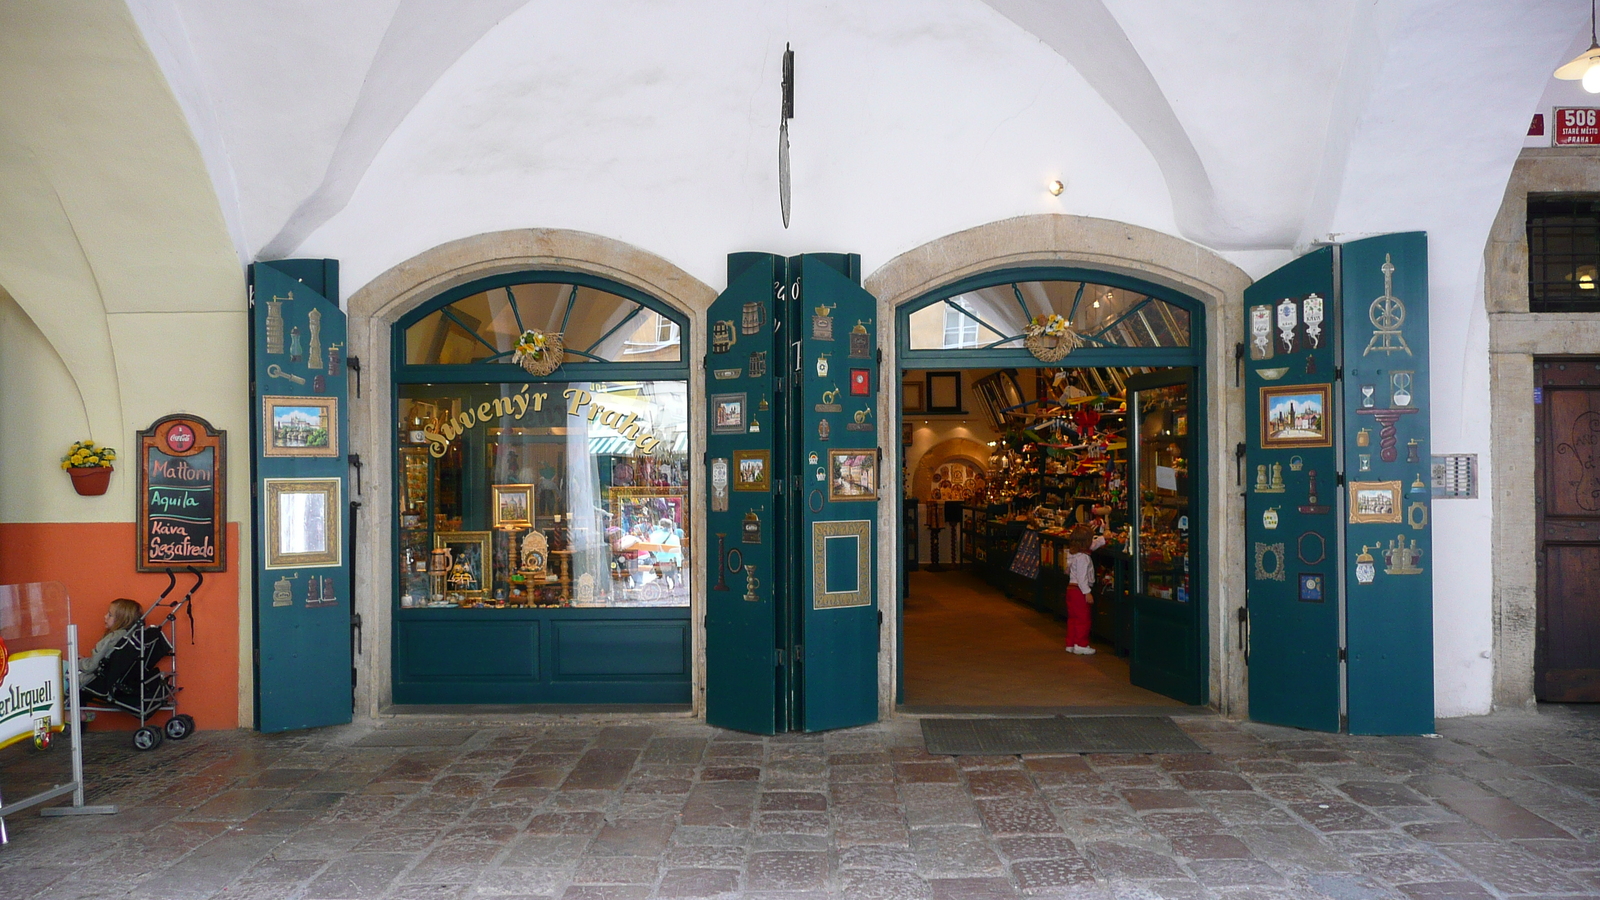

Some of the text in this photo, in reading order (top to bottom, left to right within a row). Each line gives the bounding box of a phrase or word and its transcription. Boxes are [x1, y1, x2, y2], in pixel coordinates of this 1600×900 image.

[1565, 110, 1596, 126] 506
[1562, 126, 1579, 135] STARÉ
[422, 383, 661, 459] Suvenýr Praha
[152, 460, 211, 481] Mattoni
[150, 490, 199, 512] Aquila
[149, 536, 214, 560] Segafredo
[9, 680, 52, 717] Urquell
